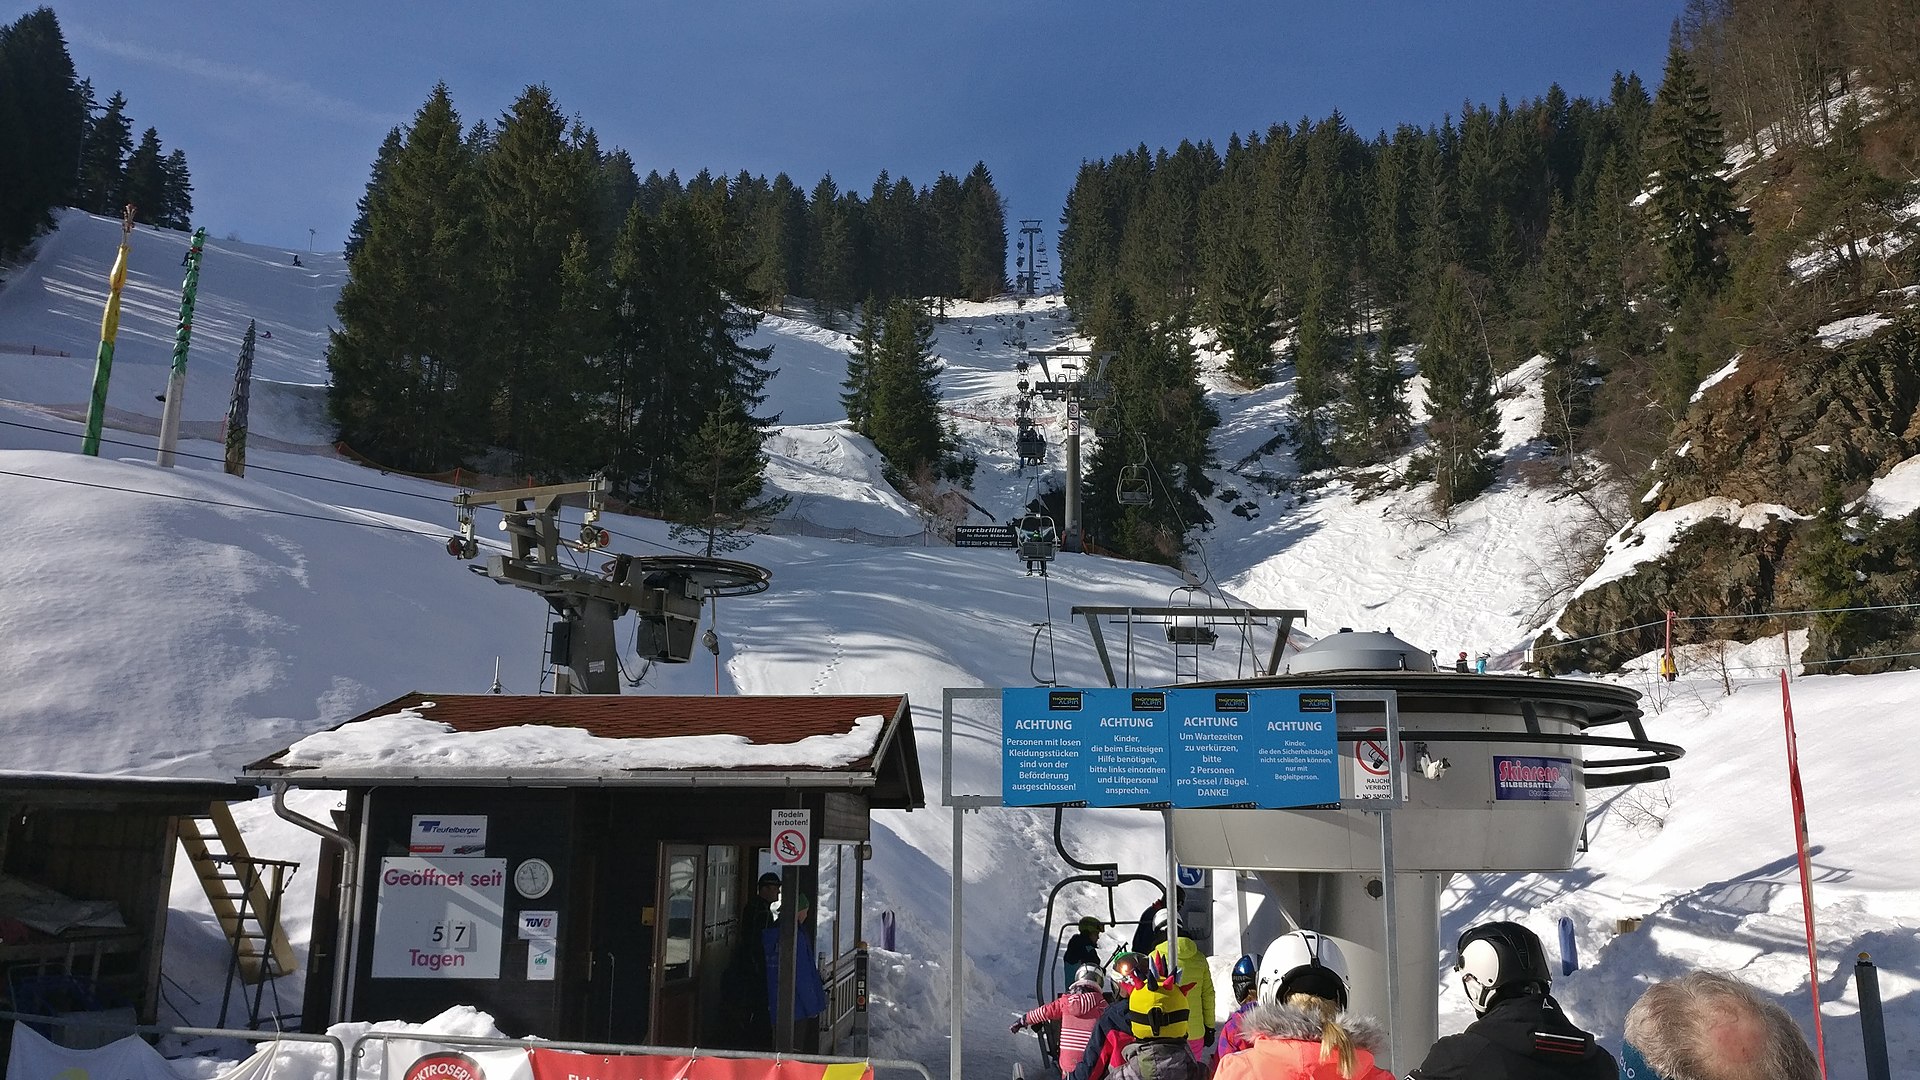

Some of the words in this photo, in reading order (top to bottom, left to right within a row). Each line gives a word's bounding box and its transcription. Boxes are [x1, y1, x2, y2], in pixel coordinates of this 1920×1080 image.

[1015, 720, 1072, 730] ACHTUNG
[1100, 718, 1153, 727] ACHTUNG
[1184, 717, 1237, 727] ACHTUNG
[1267, 722, 1322, 731] ACHTUNG
[1007, 738, 1043, 746] Personen
[1060, 738, 1081, 746] losen
[1114, 735, 1140, 743] Kinder,
[1125, 745, 1163, 754] Einsteigen
[1196, 744, 1238, 752] verkürzen,
[1282, 748, 1333, 756] Sicherheitsbügel
[1009, 749, 1078, 758] Kleidungsstücken
[1117, 756, 1157, 764] benötigen,
[1019, 771, 1069, 780] Beförderung
[1499, 760, 1560, 782] Skiarena
[1114, 776, 1158, 785] Liftpersonal
[1177, 778, 1190, 786] pro
[1224, 778, 1249, 787] Bügel.
[1012, 783, 1076, 792] ausgeschlossen!
[1106, 787, 1151, 795] ansprechen.
[384, 868, 464, 886] Geöffnet
[470, 869, 502, 886] seit
[1104, 870, 1114, 878] 44
[409, 949, 465, 971] Tagen
